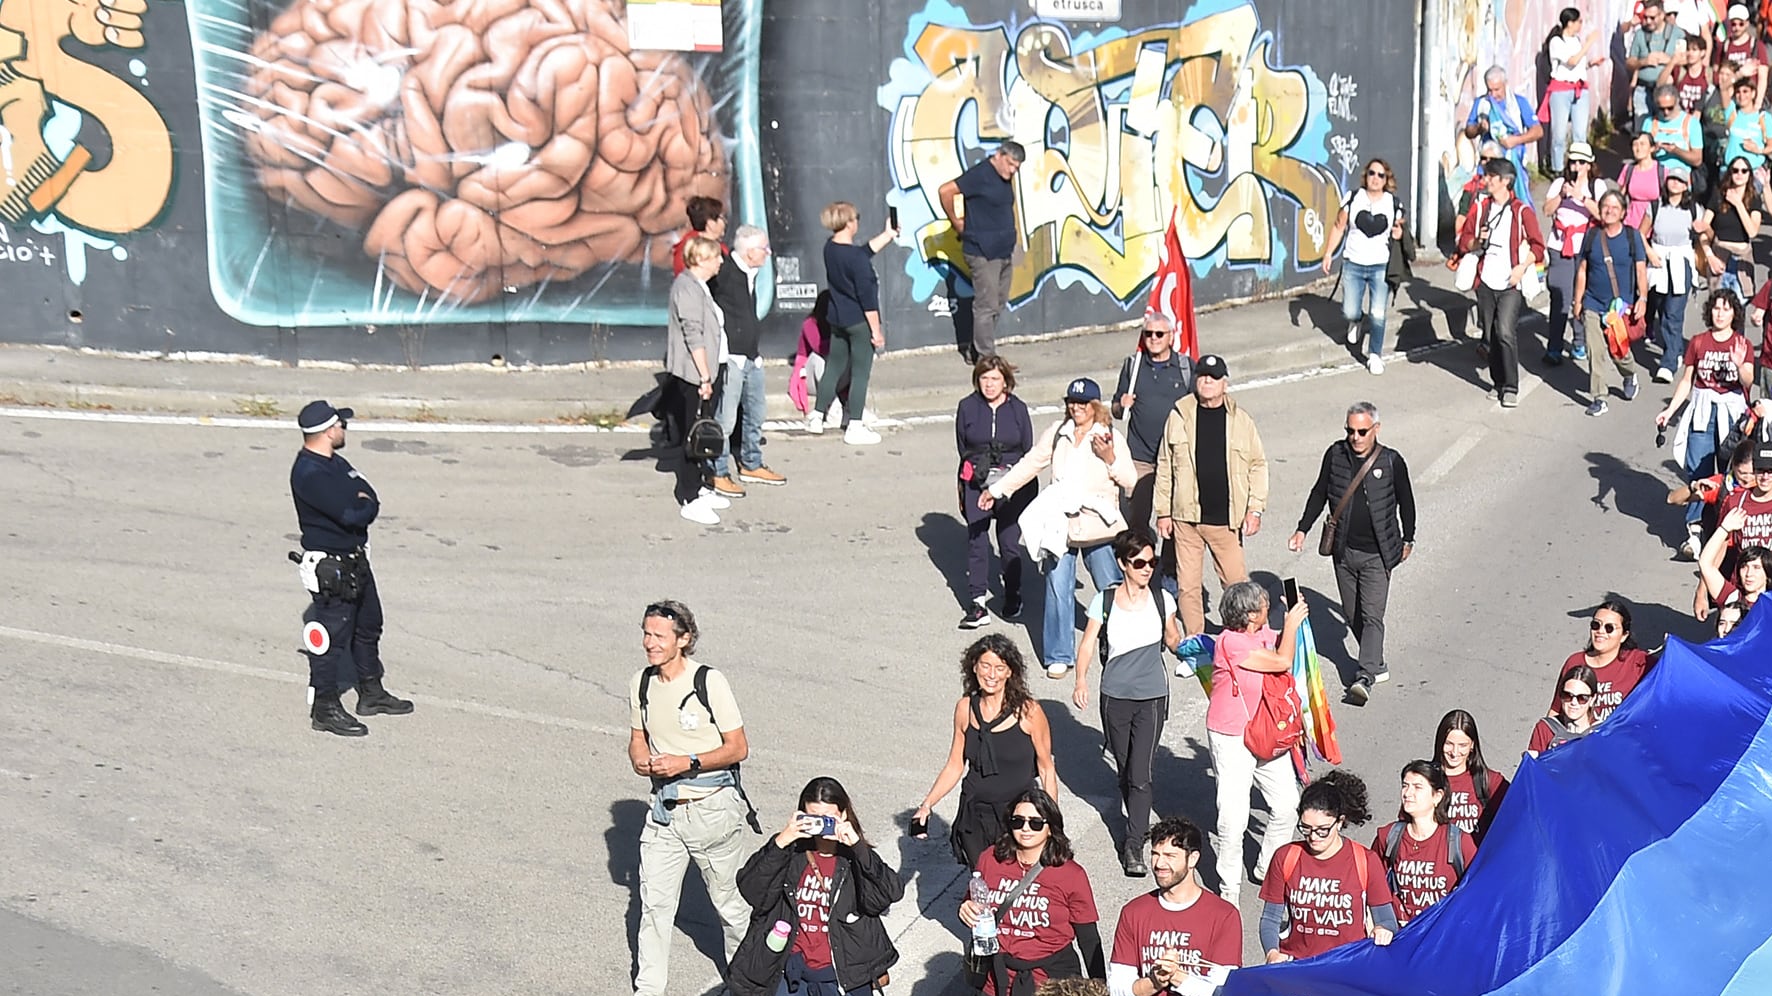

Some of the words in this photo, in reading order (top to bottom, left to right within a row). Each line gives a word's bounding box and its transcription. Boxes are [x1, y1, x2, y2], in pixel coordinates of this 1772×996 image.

[1451, 792, 1469, 805] KE
[1447, 804, 1479, 819] MUS
[1455, 819, 1479, 834] ALLS
[1398, 860, 1436, 875] MAKE
[804, 875, 833, 891] MAK
[1299, 876, 1340, 894] MAKE
[1397, 873, 1448, 890] UMMUS
[1290, 889, 1353, 909] HUMMUS
[797, 904, 817, 921] OT
[1009, 910, 1049, 929] WALLS
[1313, 909, 1353, 928] WALLS
[1150, 931, 1191, 946] MAKE
